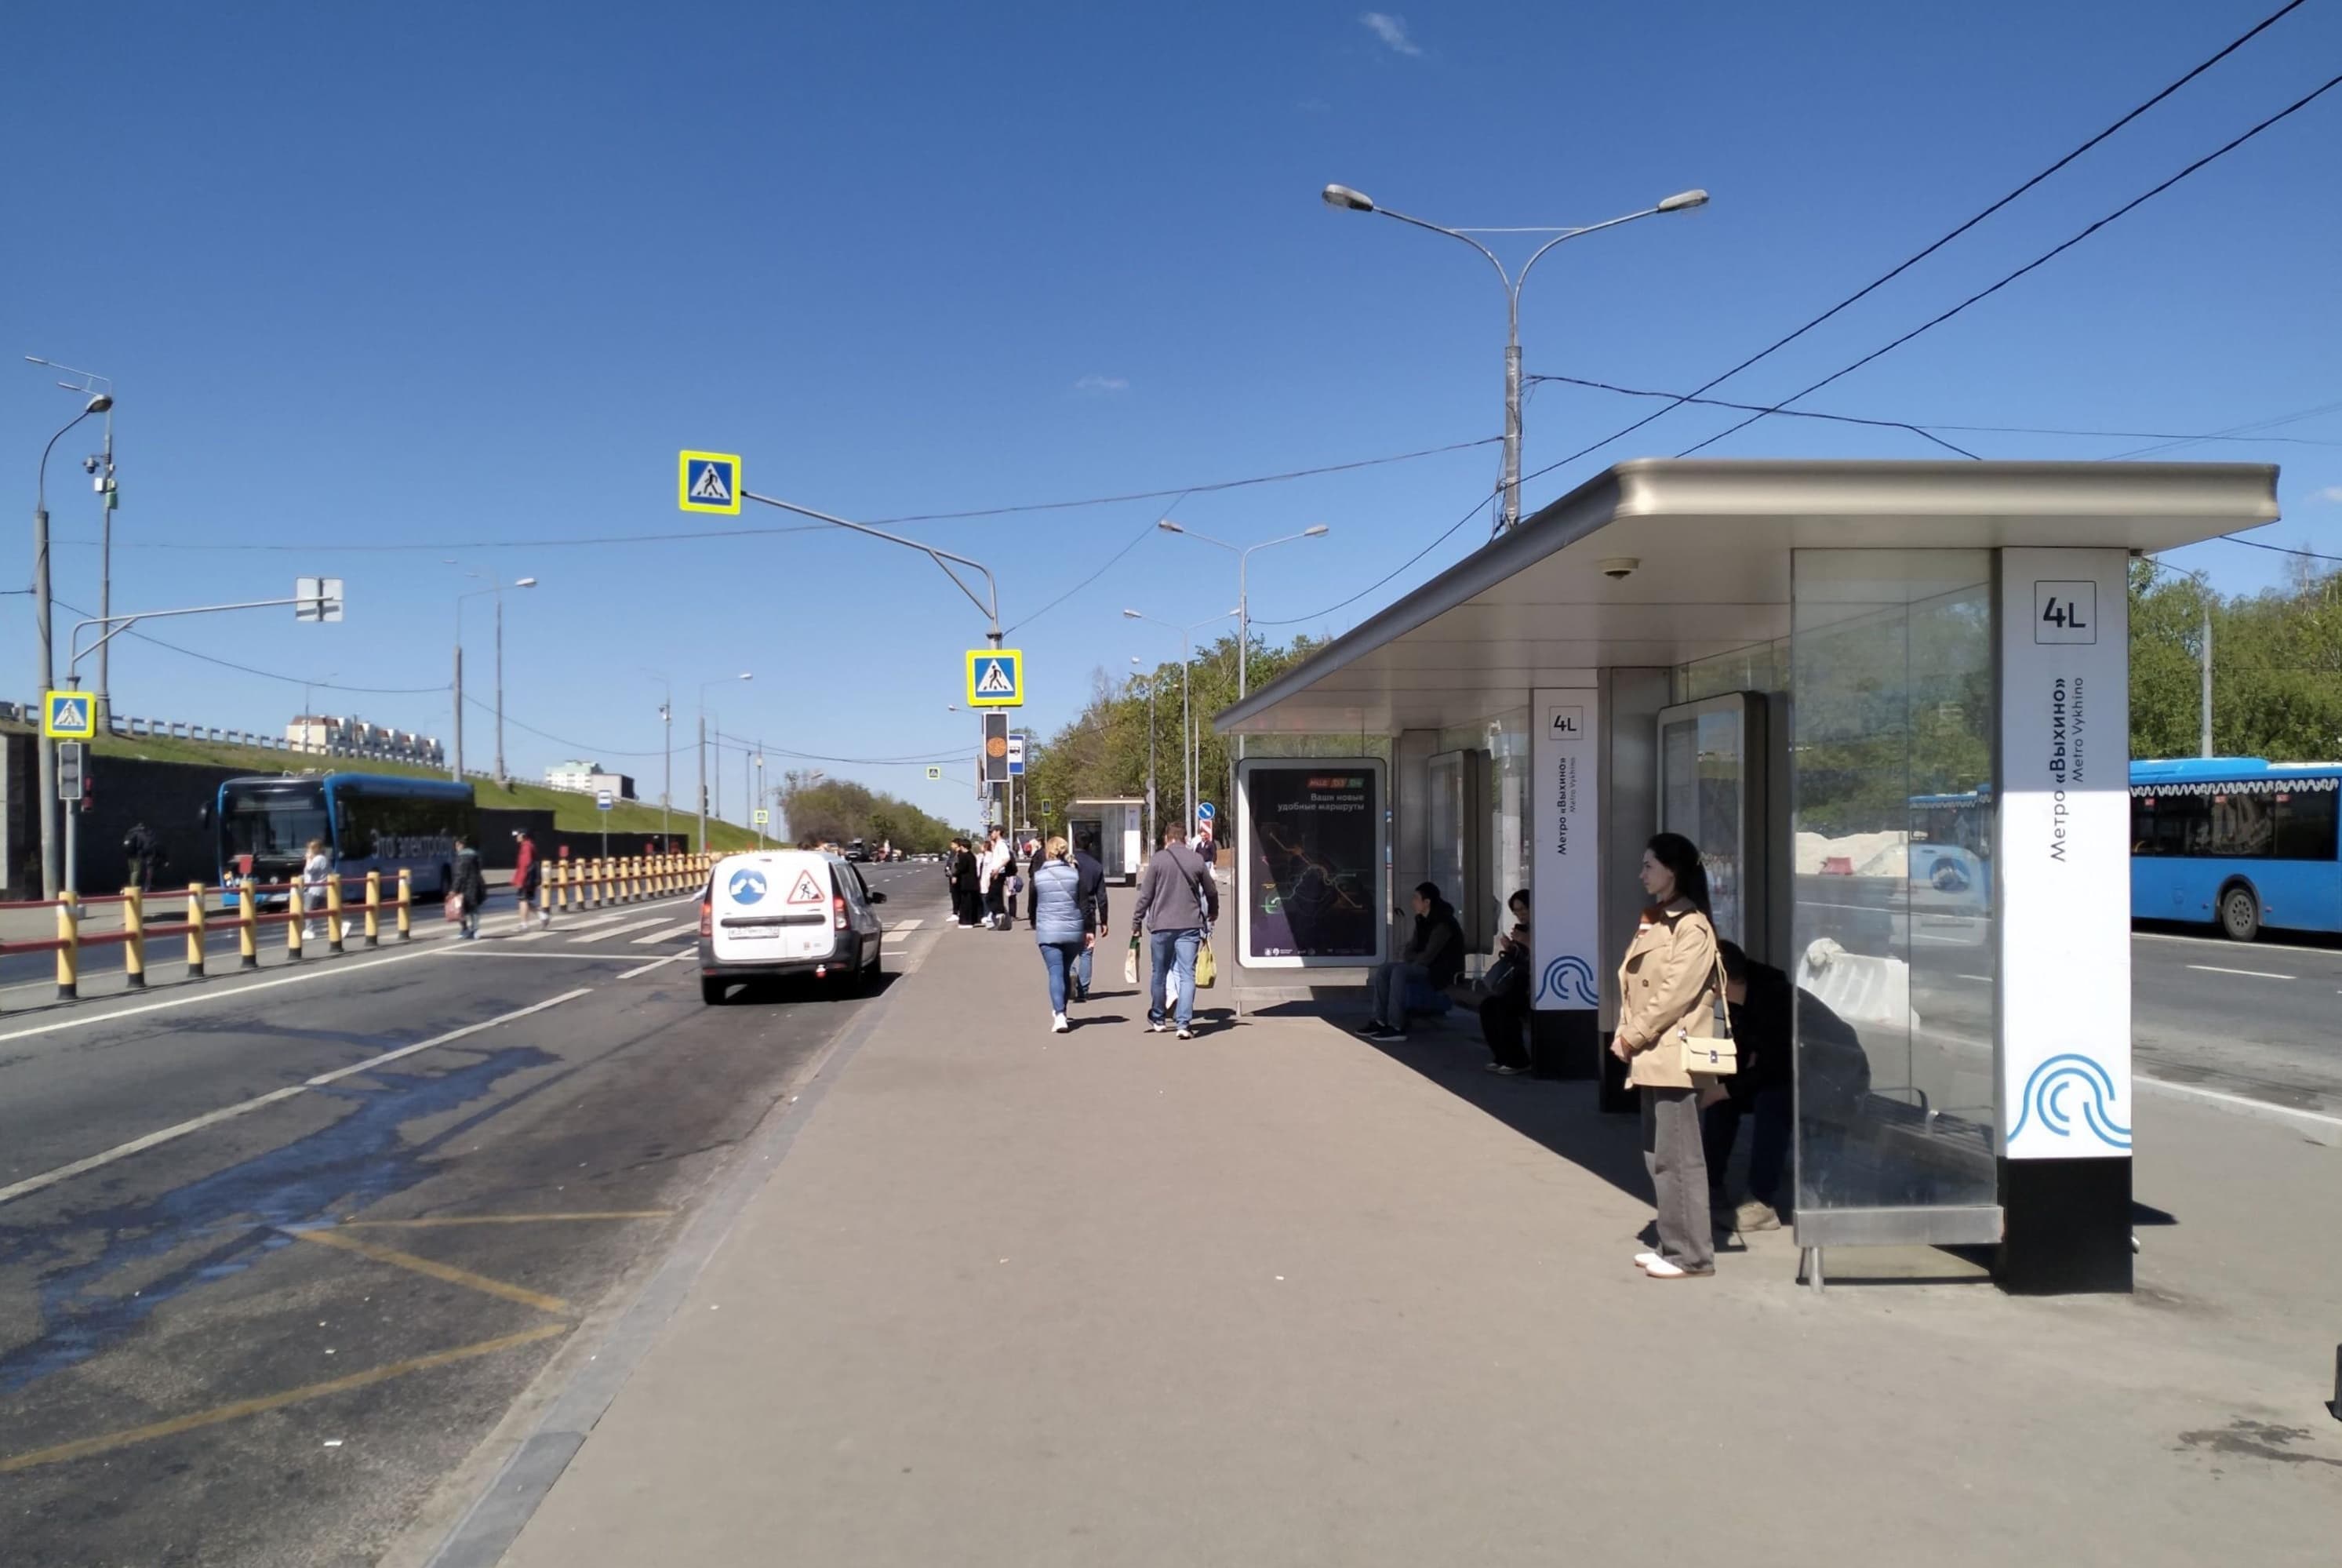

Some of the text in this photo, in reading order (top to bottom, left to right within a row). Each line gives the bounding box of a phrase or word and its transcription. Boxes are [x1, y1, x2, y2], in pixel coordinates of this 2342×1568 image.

[2043, 597, 2086, 628] 4L
[1553, 715, 1577, 731] 4L
[2072, 677, 2086, 783] Metro Vykhino
[2050, 678, 2069, 862] Метро «Выхино»
[1278, 802, 1315, 811] удобные
[1557, 757, 1569, 856] Метро «Выхино»
